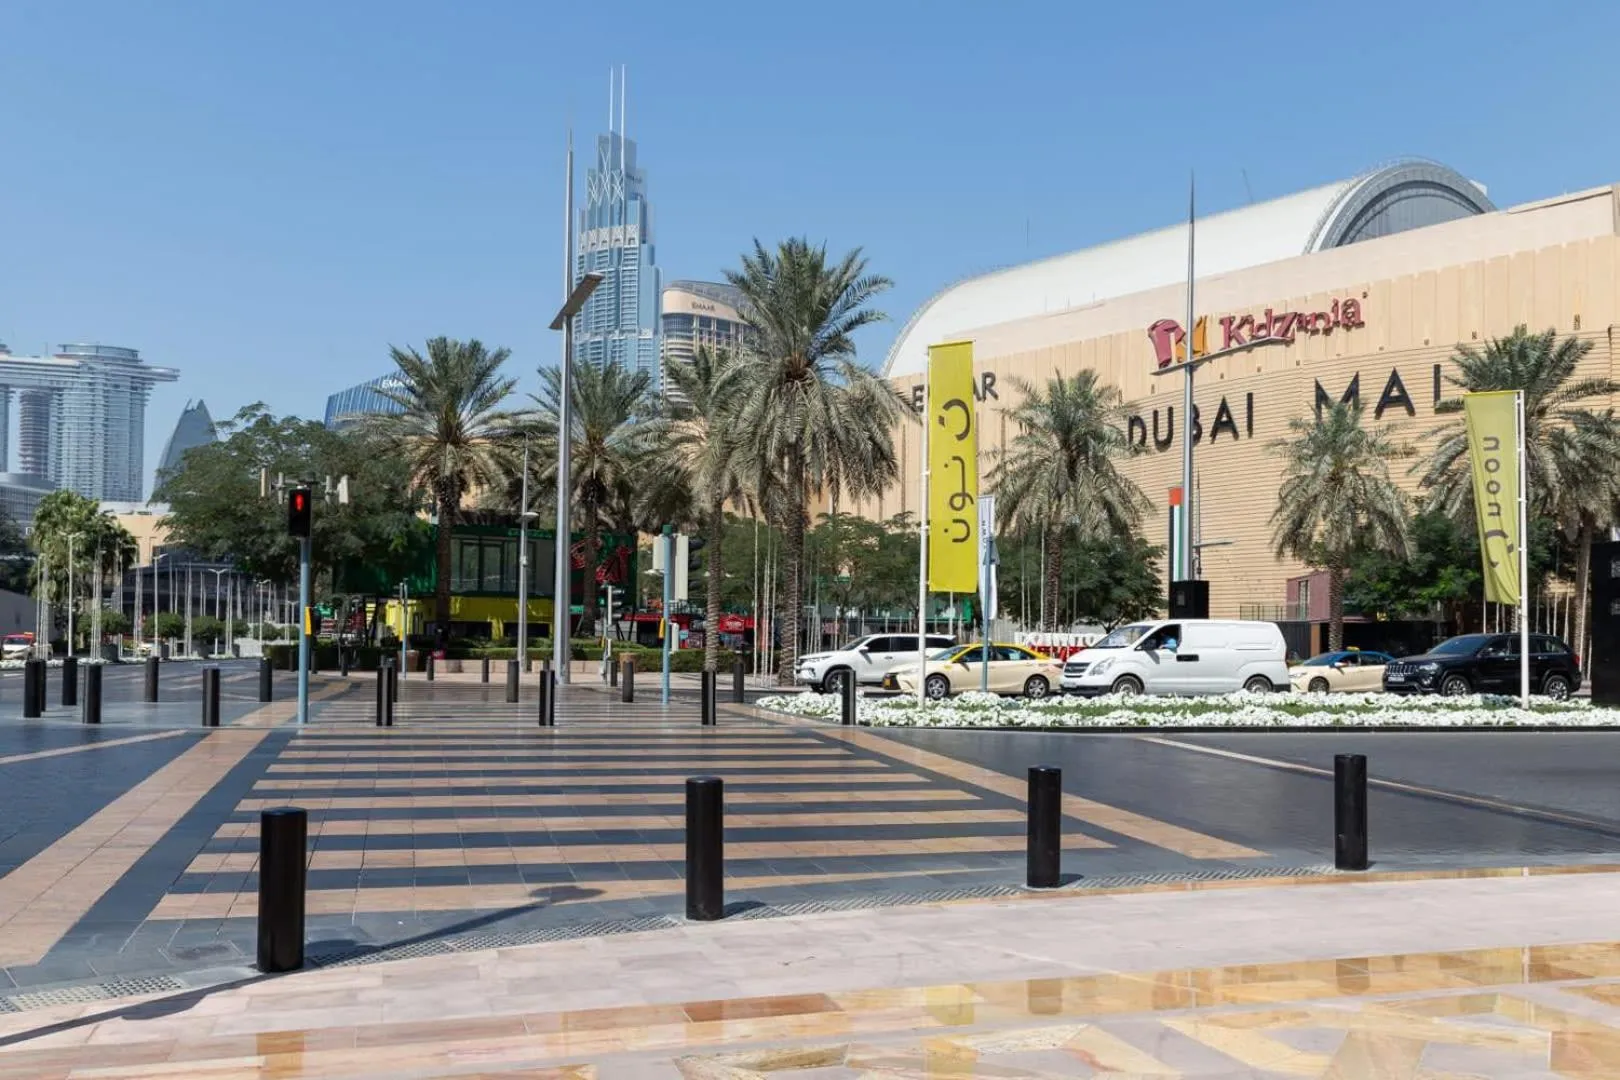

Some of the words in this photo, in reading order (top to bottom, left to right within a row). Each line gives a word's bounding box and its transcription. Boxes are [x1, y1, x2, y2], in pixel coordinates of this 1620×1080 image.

[1127, 392, 1254, 453] DUBAI
[1313, 363, 1467, 427] MAL
[1483, 436, 1501, 517] noon
